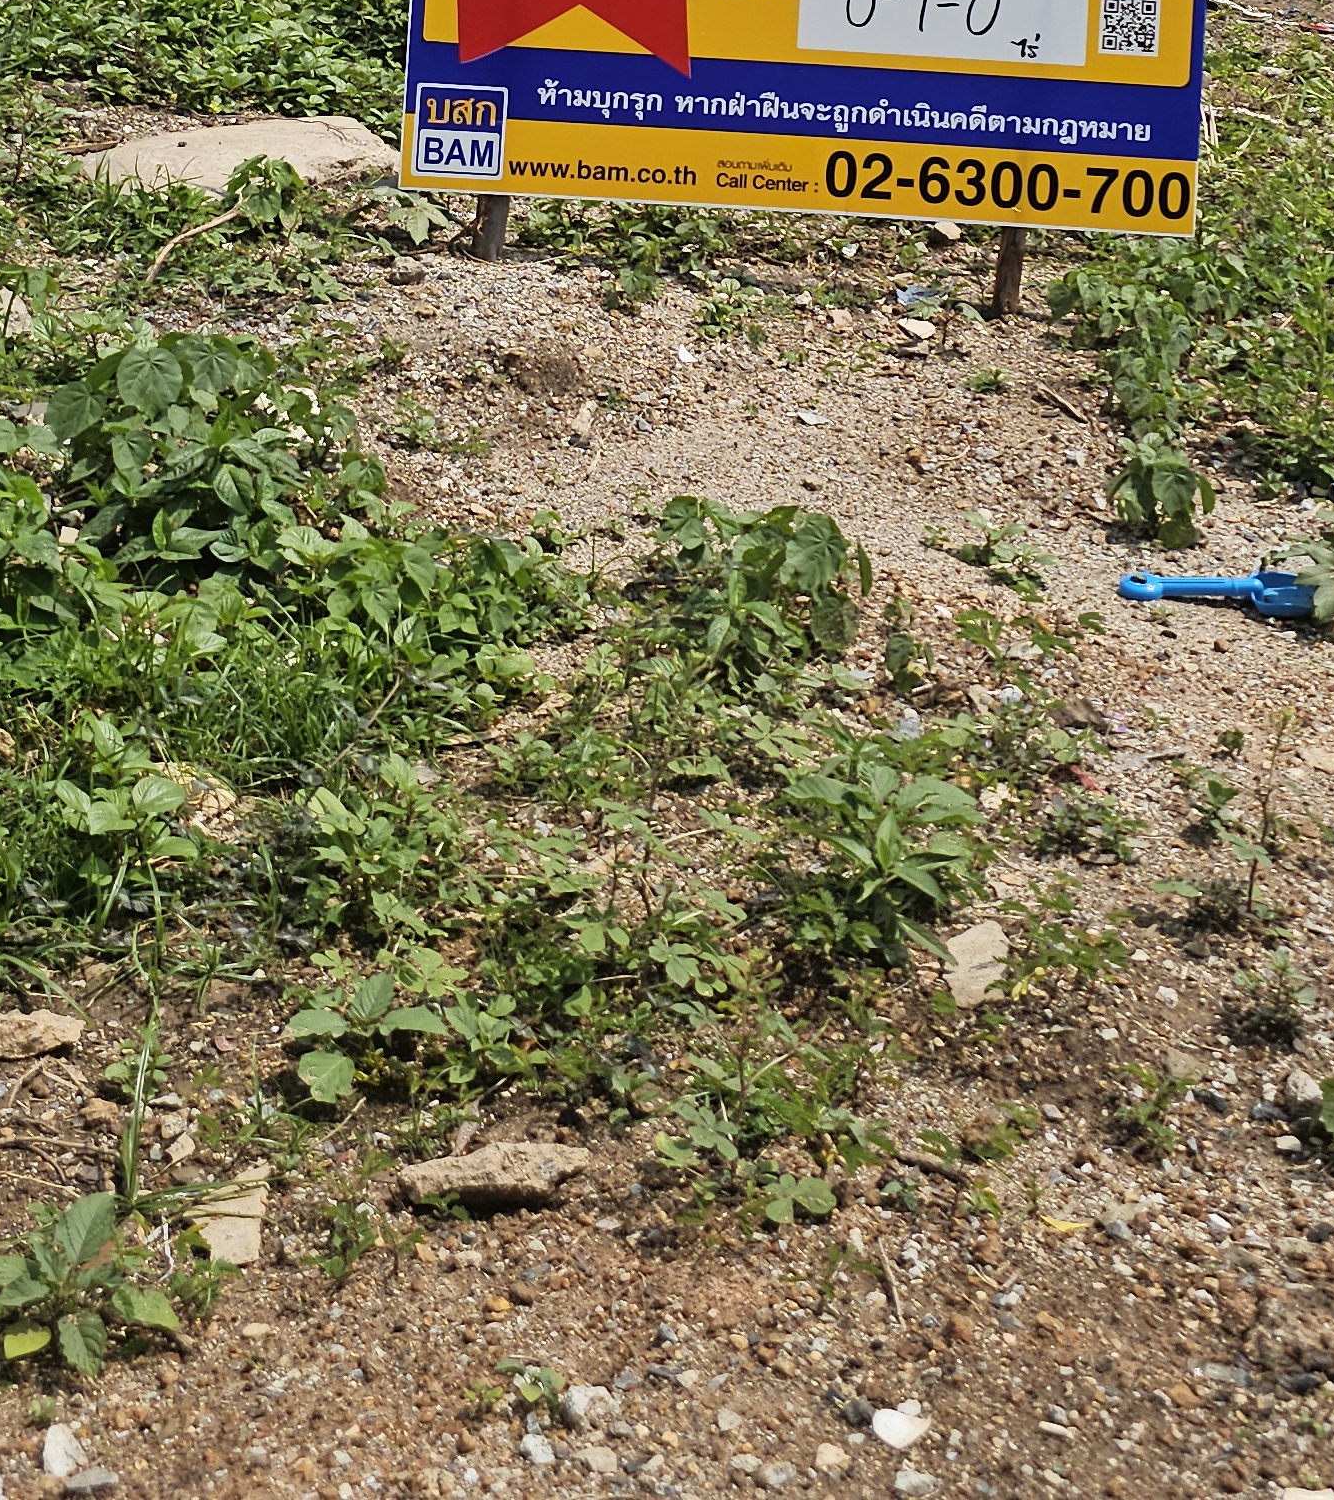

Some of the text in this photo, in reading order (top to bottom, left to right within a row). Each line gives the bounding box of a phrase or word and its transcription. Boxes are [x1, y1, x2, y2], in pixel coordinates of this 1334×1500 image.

[426, 96, 498, 128] บสก
[536, 77, 1152, 145] ห้ามบุกรุก หากฝ่าฝืนจะถูกดำเนินคดีตามกฎหมาย
[422, 136, 495, 169] BAM
[508, 159, 698, 187] www.bam.co.th
[716, 172, 748, 189] Call
[752, 174, 809, 192] Center
[824, 150, 1191, 220] 02-6300-700
